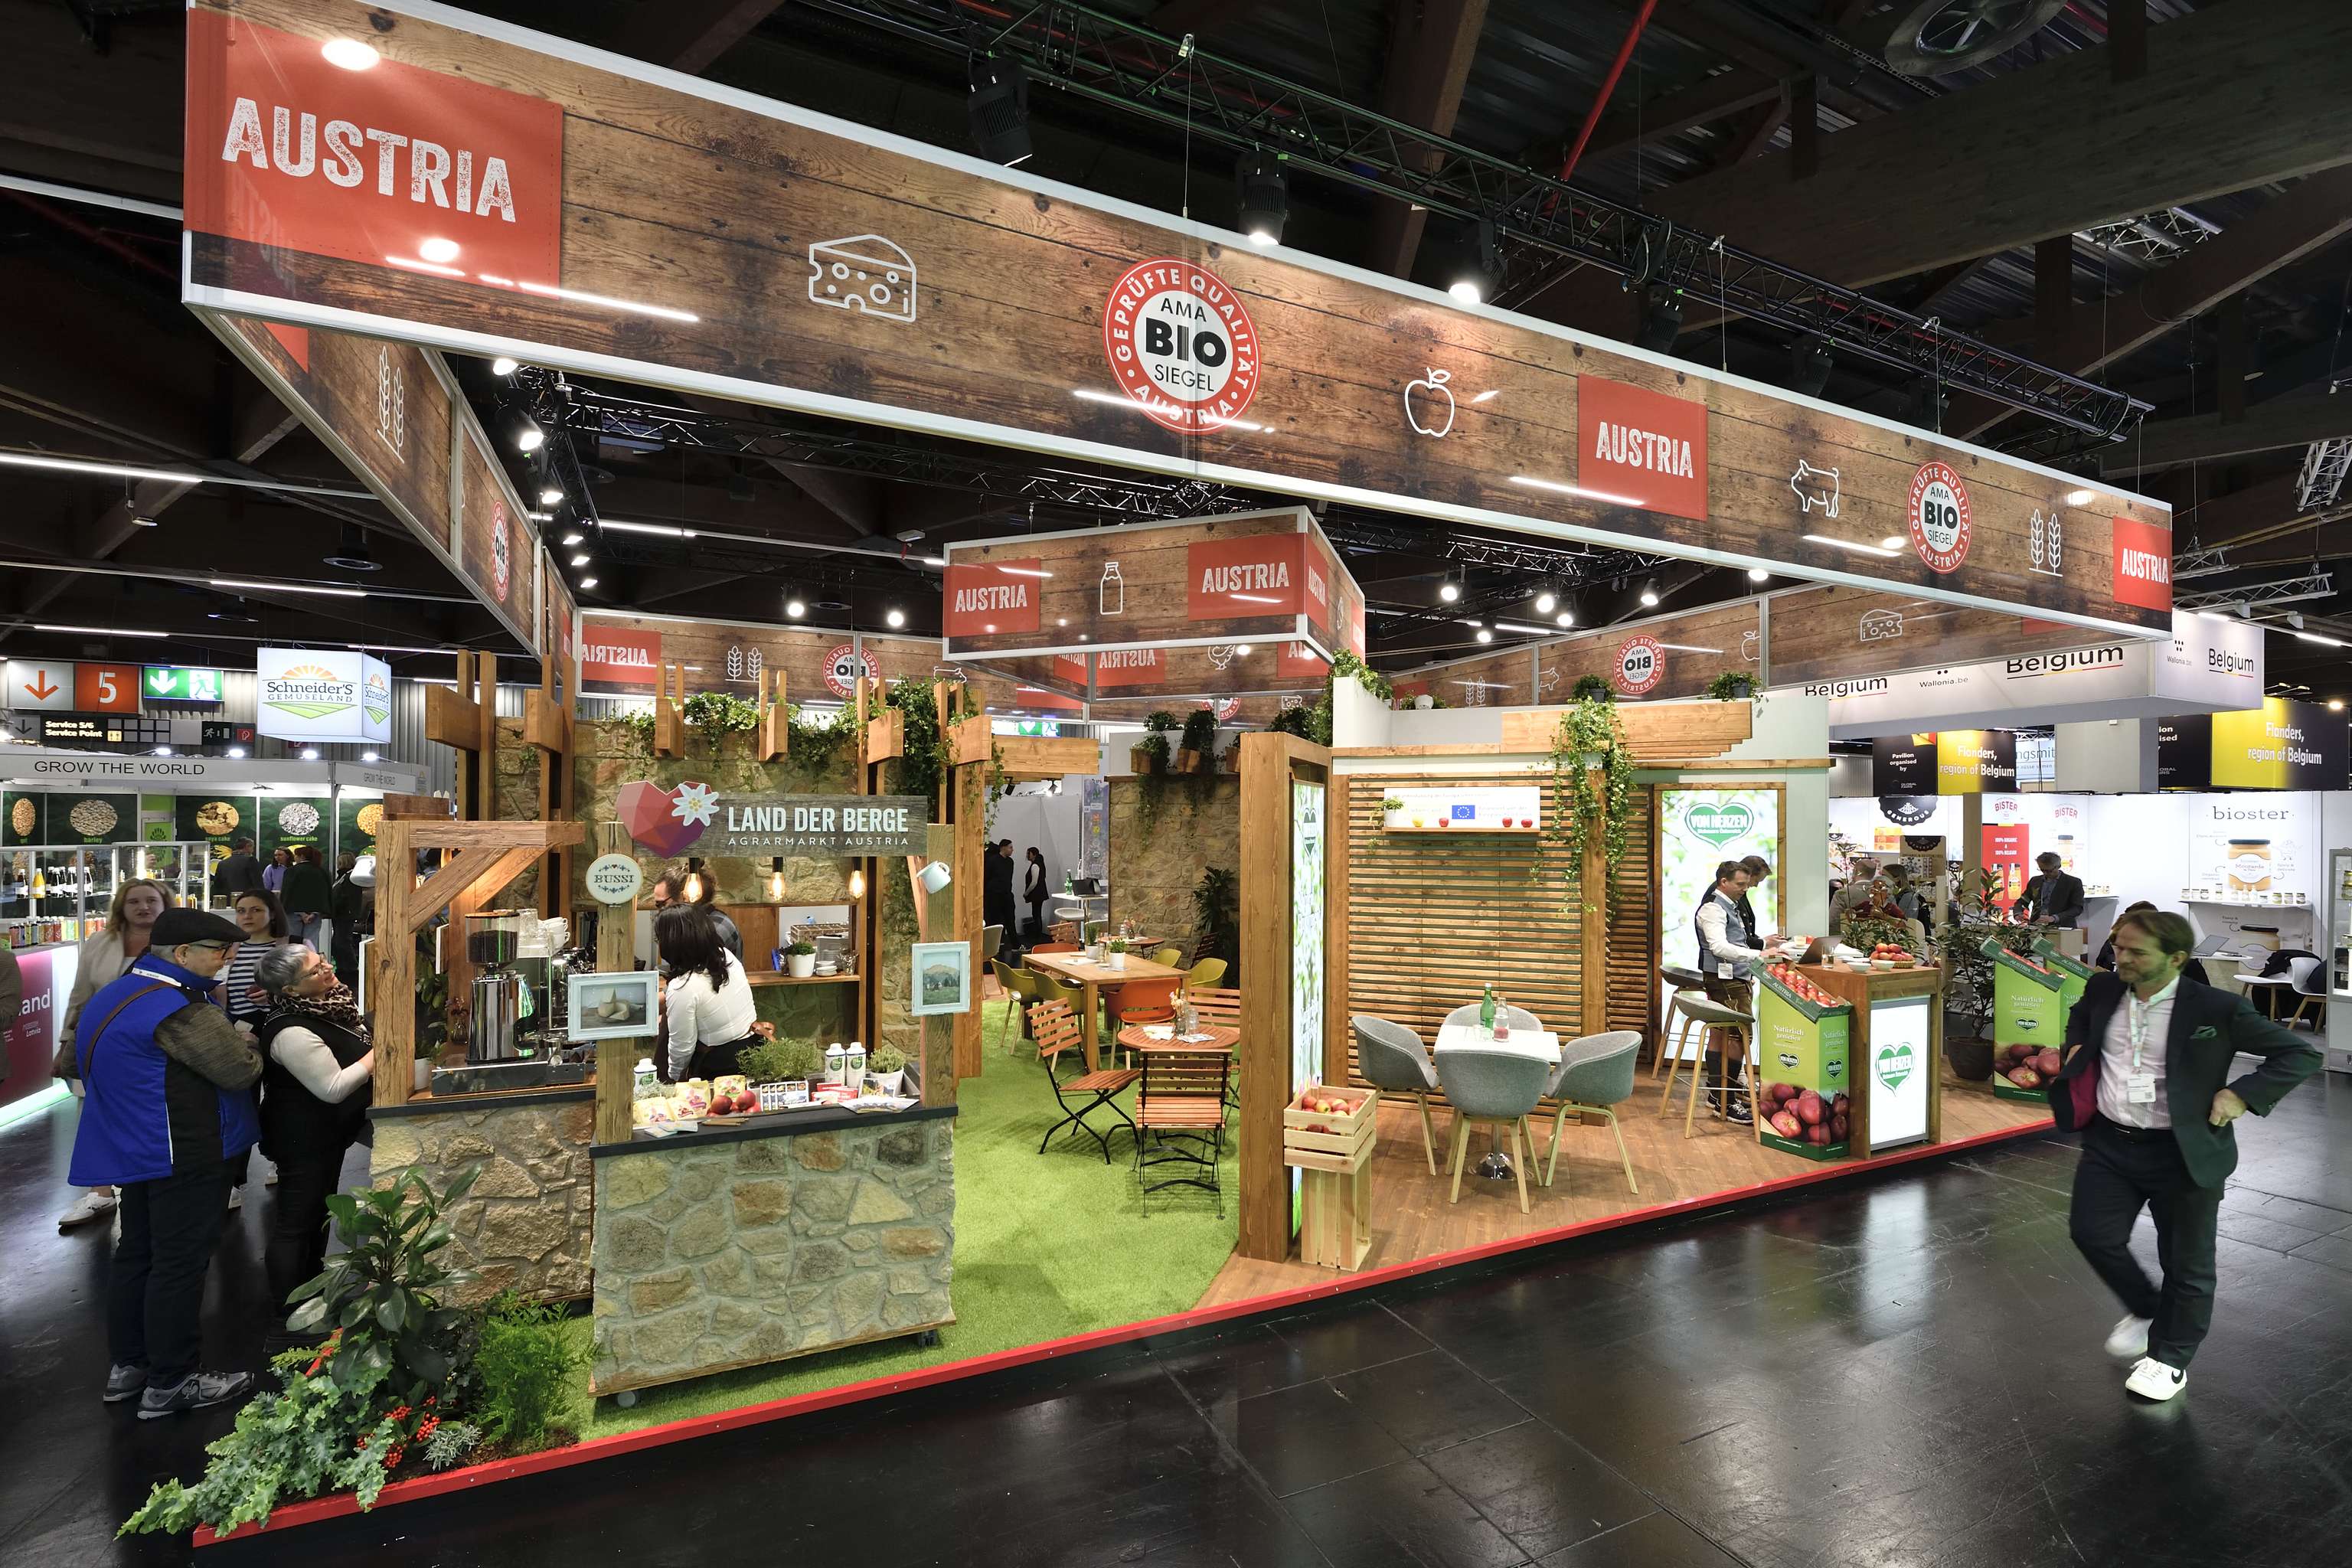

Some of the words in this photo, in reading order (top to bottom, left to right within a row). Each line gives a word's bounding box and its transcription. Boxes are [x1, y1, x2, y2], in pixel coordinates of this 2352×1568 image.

[222, 97, 516, 223] AUSTRIA
[1161, 297, 1207, 322] AMA
[1113, 269, 1181, 362] GEPRÜFTE
[1190, 275, 1255, 390] QUALITÄT
[1145, 317, 1227, 368] BIO
[1154, 364, 1214, 392] SIEGEL
[1134, 384, 1234, 425] AUSTRIA
[1596, 421, 1694, 479] AUSTRIA
[1930, 486, 1950, 501] AMA
[1911, 467, 1939, 531] GEPRÜFTE
[1942, 470, 1970, 543] QUALITÄT
[1924, 500, 1958, 530] BIO
[1928, 529, 1953, 546] SIEGEL
[1919, 544, 1961, 567] AUSTRIA
[2122, 547, 2169, 584] AUSTRIA
[1201, 562, 1290, 593] AUSTRIA
[1308, 565, 1326, 607] AUSTRIA
[955, 584, 1027, 612] AUSTRIA
[2006, 646, 2124, 674] Belgium
[2209, 648, 2255, 672] Belgium
[99, 671, 117, 704] 5
[267, 681, 353, 695] Schneider'S
[1919, 677, 1968, 688] Wallonia.be
[268, 694, 352, 703] GEMUSELAND
[45, 720, 77, 729] Service
[45, 729, 77, 737] Service
[79, 730, 103, 738] Point
[2266, 722, 2304, 743] Flanders,
[1957, 746, 1998, 761] Flanders,
[2247, 747, 2275, 762] region
[2277, 746, 2285, 761] of
[2288, 746, 2322, 766] Belgium
[34, 761, 93, 773] GROW
[99, 763, 134, 774] THE
[140, 763, 204, 775] WORLD
[1939, 764, 1967, 776] region
[1969, 763, 1979, 775] of
[1980, 764, 2015, 778] Belgium
[1886, 809, 1929, 822] GENEROUS
[1994, 801, 2018, 812] BISTER
[2055, 807, 2078, 818] BISTER
[2213, 806, 2289, 820] bioster
[728, 807, 786, 832] LAND
[795, 807, 835, 832] DER
[843, 808, 909, 832] BERGE
[728, 837, 836, 845] AGRARMARKT
[845, 837, 909, 845] AUSTRIA
[593, 874, 635, 884] BUSSI
[1772, 982, 1792, 998] AUSTRIA
[1773, 1024, 1804, 1037] Natürlich
